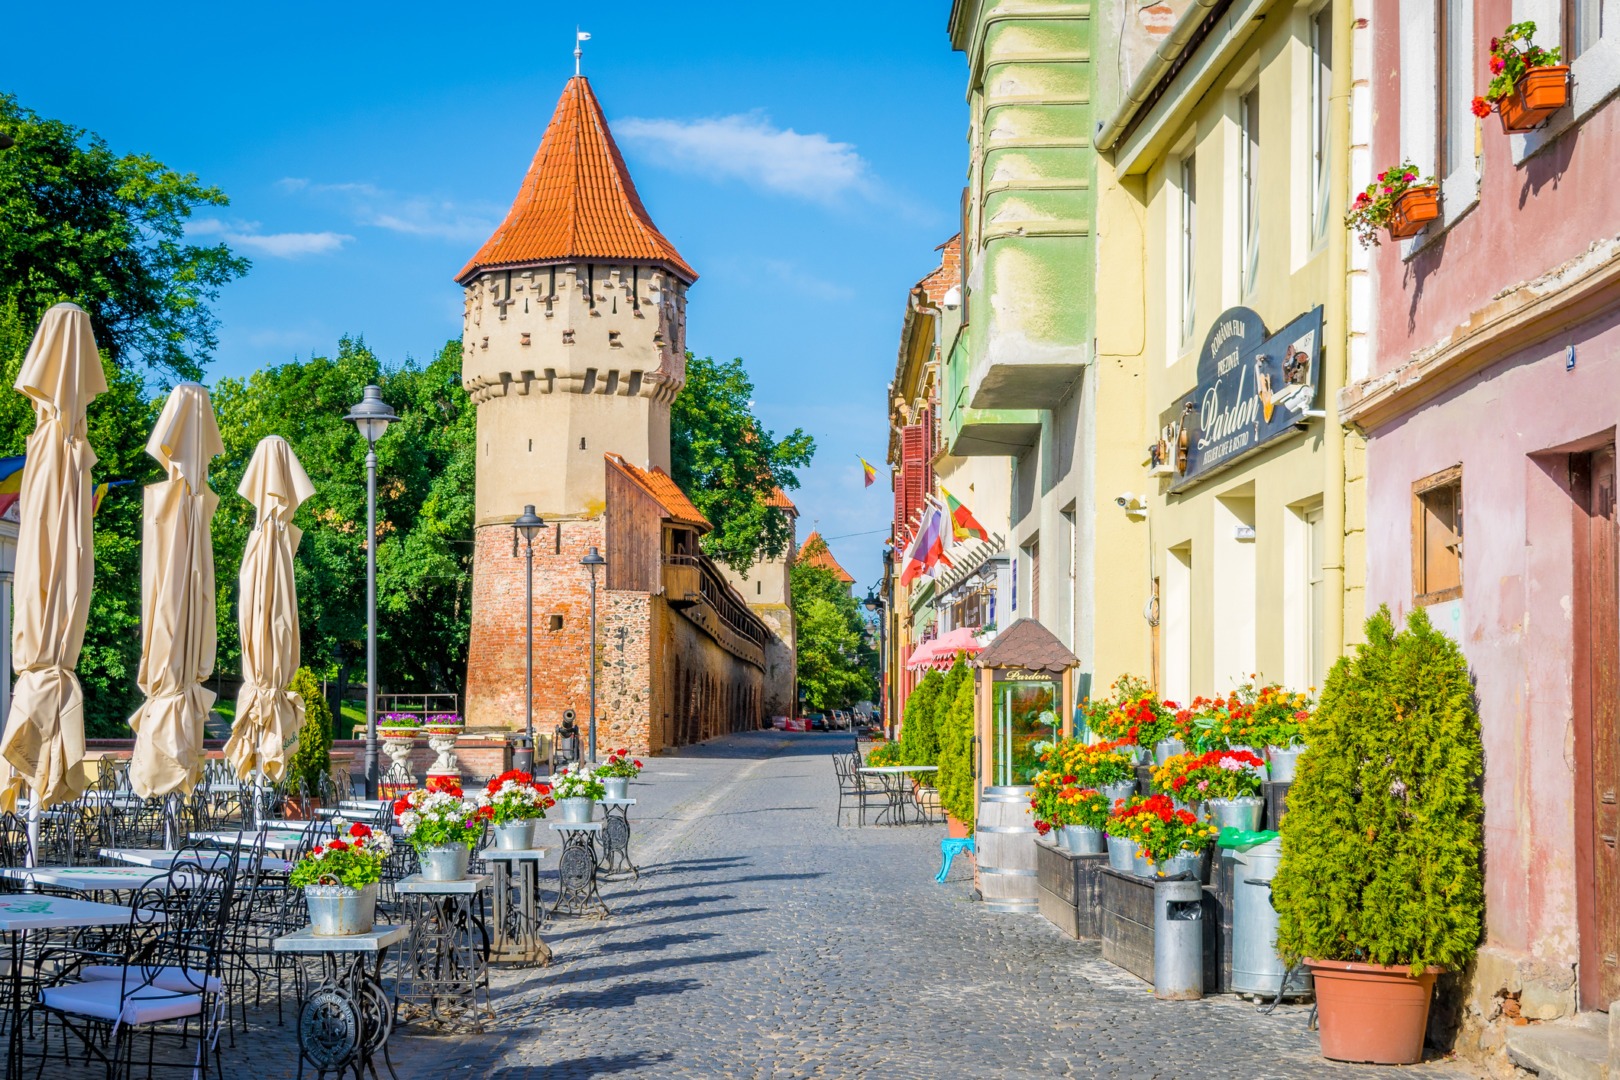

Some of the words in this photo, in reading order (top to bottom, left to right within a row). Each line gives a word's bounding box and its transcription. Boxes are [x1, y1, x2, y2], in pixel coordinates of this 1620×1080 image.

[1232, 319, 1245, 339] FILM
[1198, 364, 1259, 450] Pardon
[1233, 431, 1249, 452] BISTRO
[1004, 670, 1052, 681] Pardon
[315, 994, 342, 1005] SINGER
